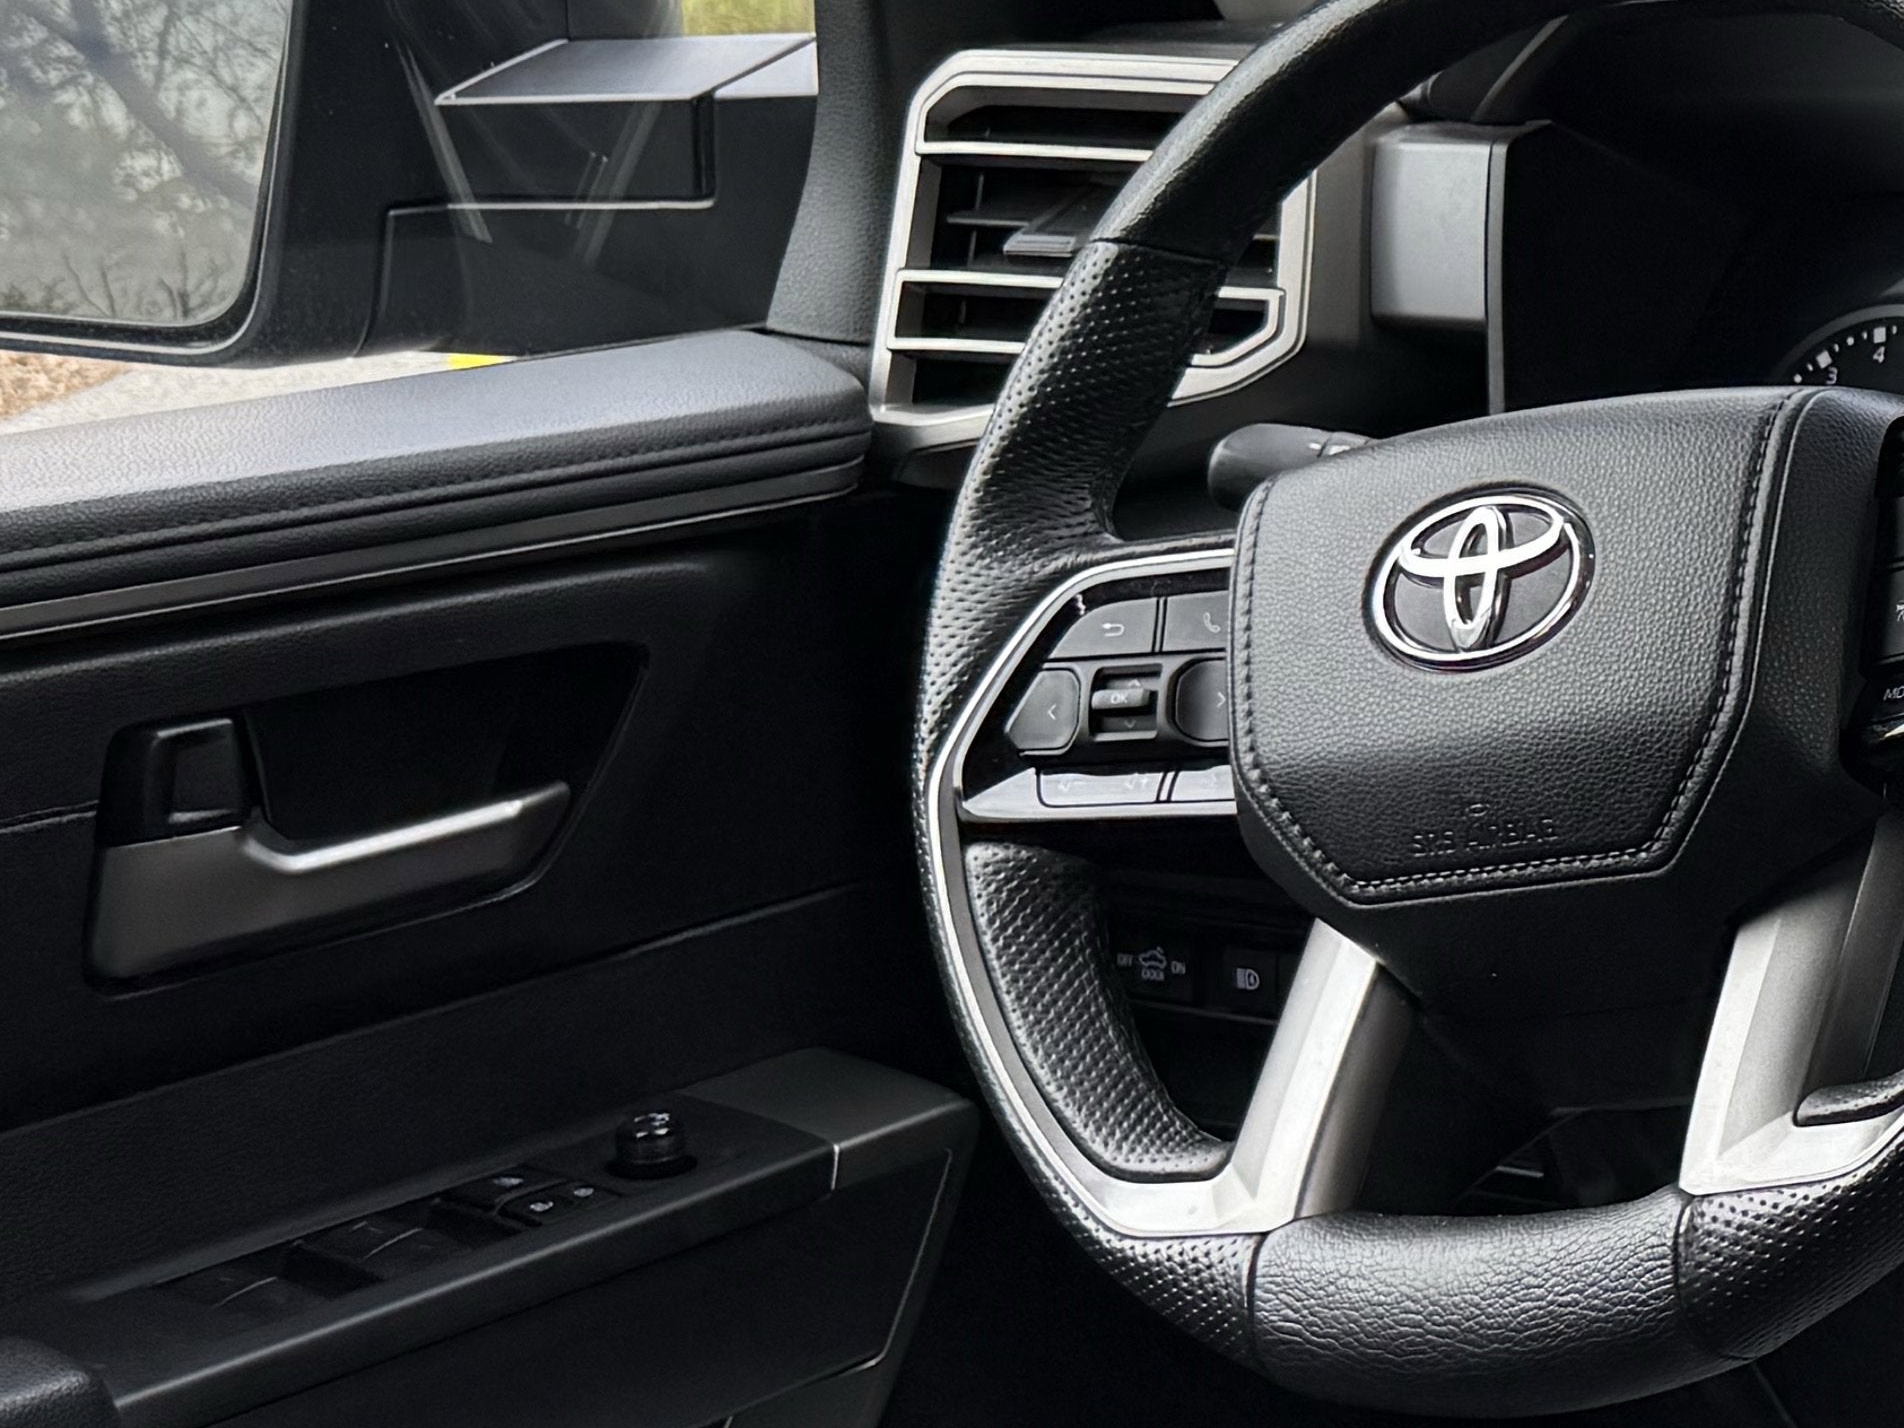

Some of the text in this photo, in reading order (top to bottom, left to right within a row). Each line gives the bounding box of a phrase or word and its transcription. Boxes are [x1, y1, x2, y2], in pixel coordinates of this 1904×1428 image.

[1872, 346, 1886, 364] 4
[1825, 367, 1838, 385] 3
[1110, 693, 1129, 705] OK
